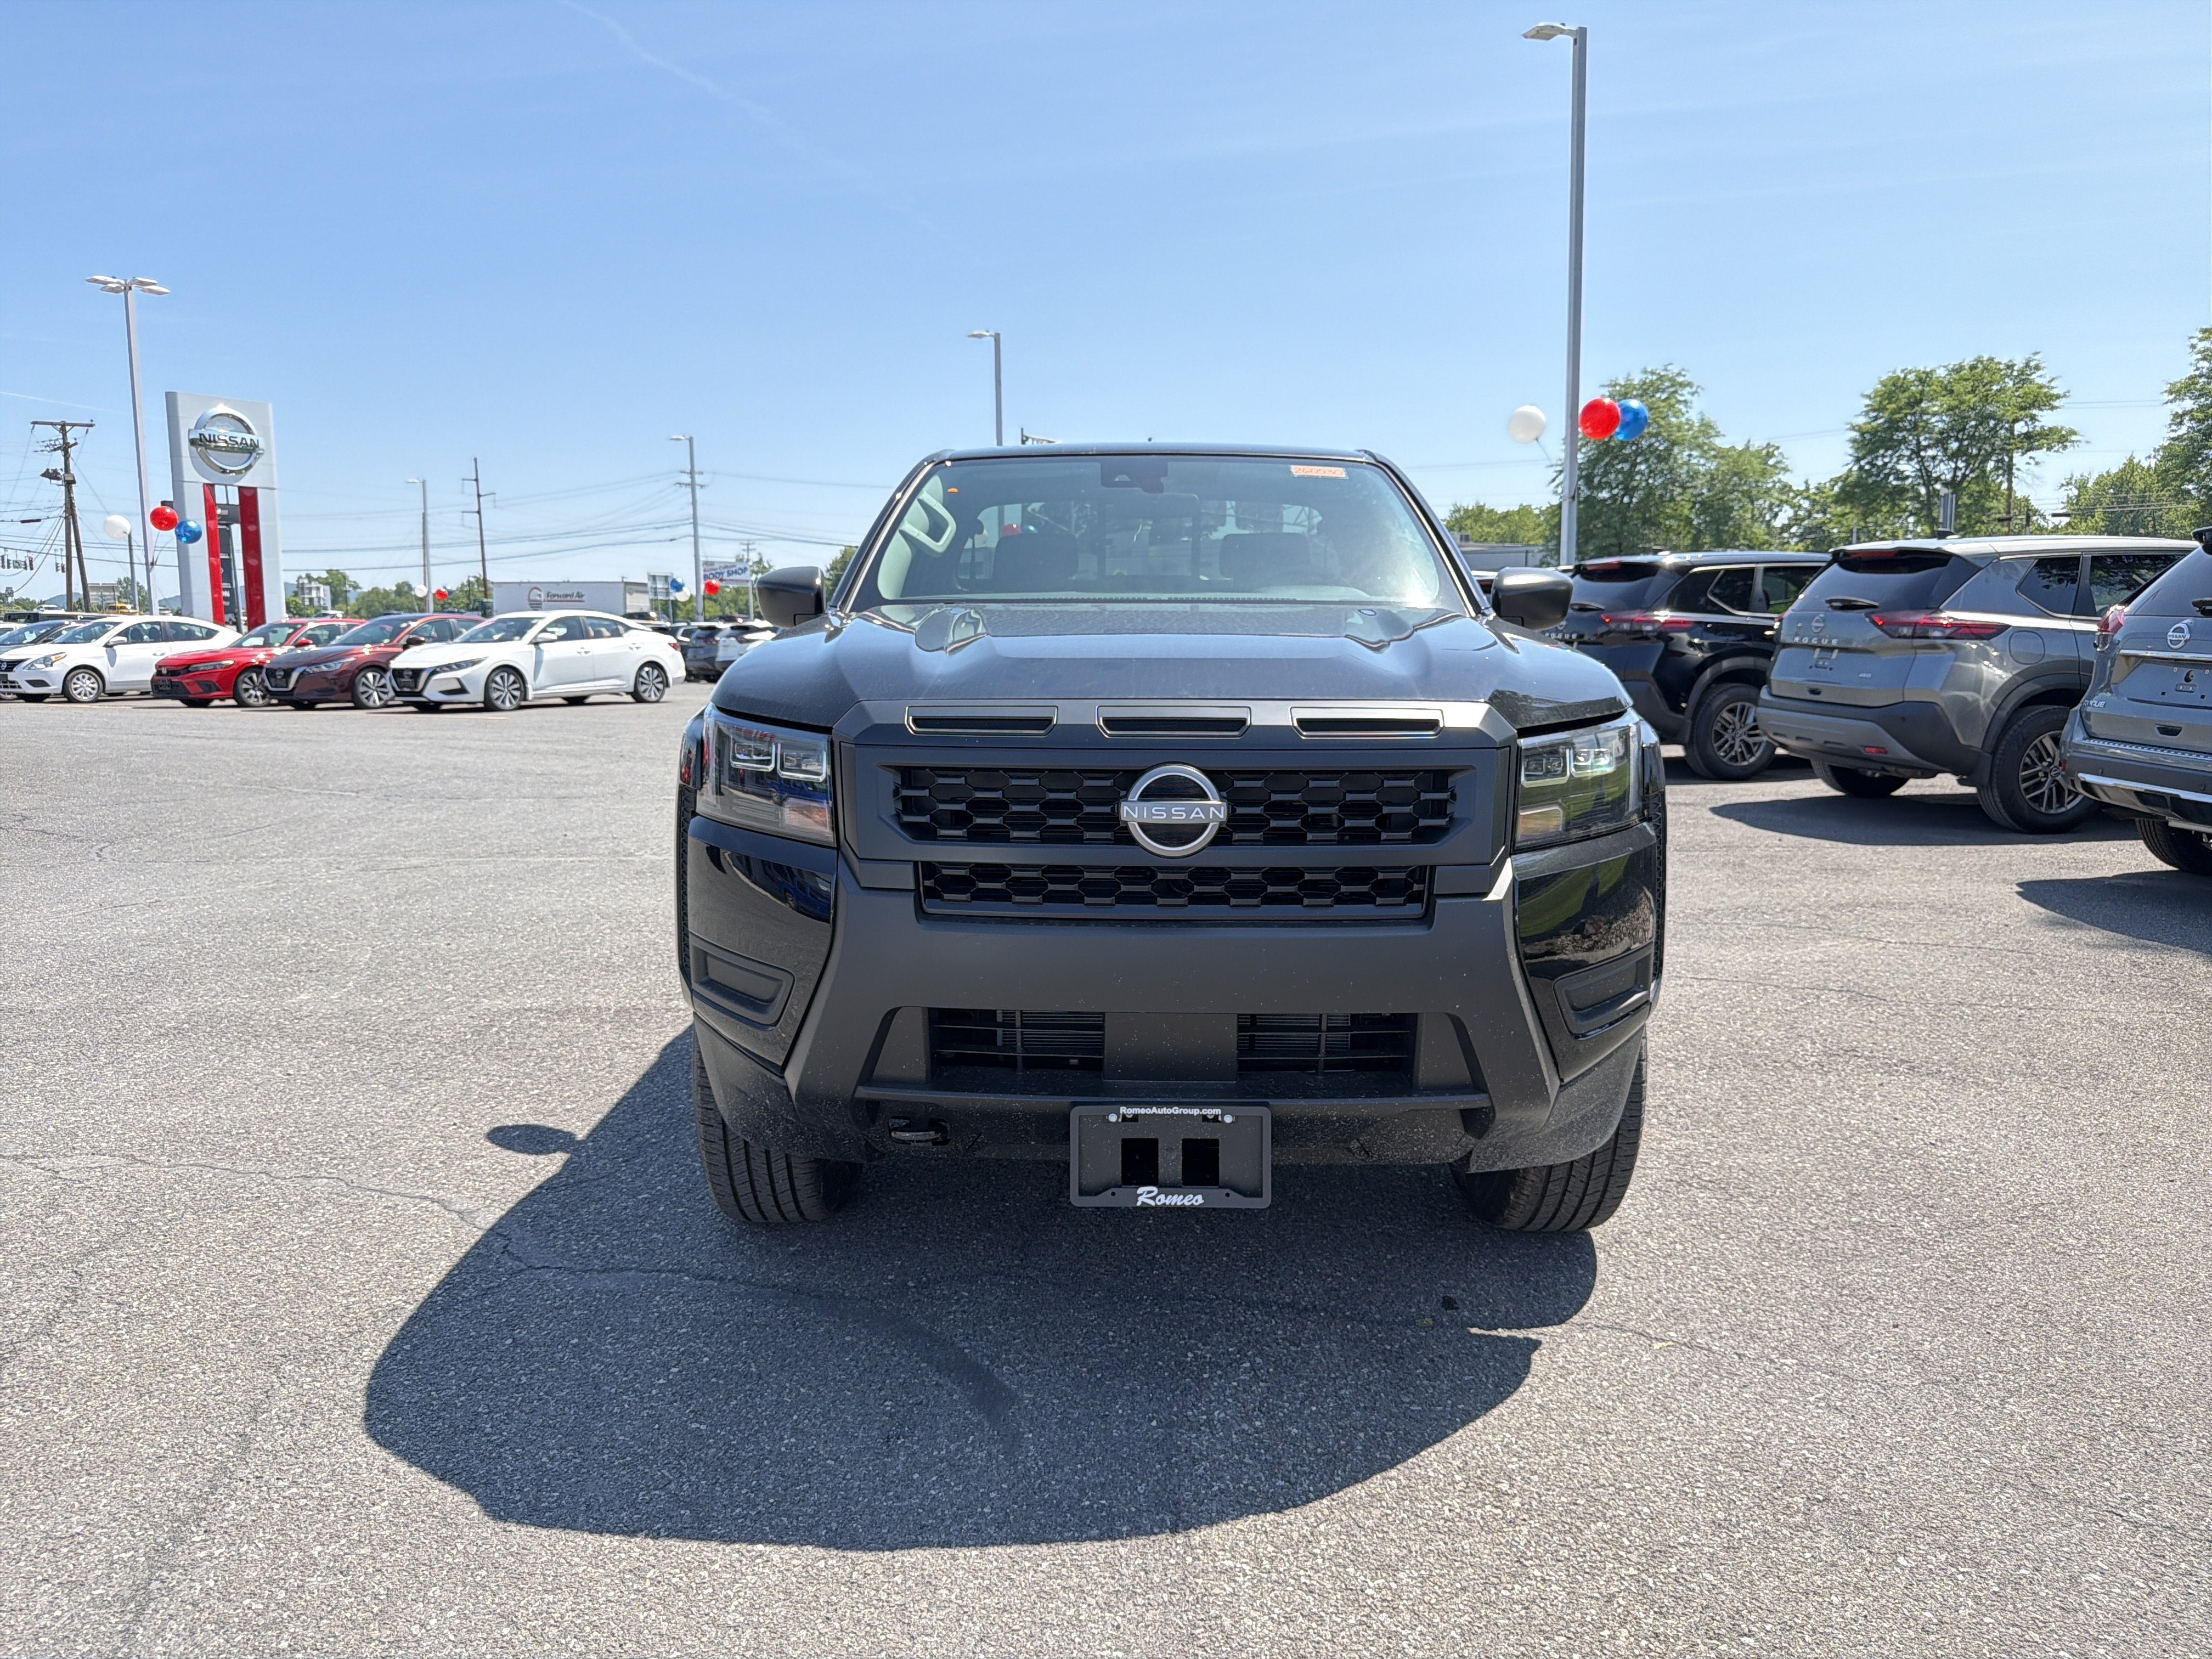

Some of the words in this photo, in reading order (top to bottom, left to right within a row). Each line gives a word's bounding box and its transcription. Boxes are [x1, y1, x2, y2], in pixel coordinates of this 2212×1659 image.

[198, 433, 259, 448] NISSAN
[703, 571, 724, 580] BODY
[727, 566, 748, 577] SHOP
[1793, 636, 1838, 646] ROGUE
[1123, 805, 1224, 820] NISSAN
[1120, 1106, 1222, 1116] RomeoAutoGroup.com
[1136, 1186, 1205, 1206] Romeo
